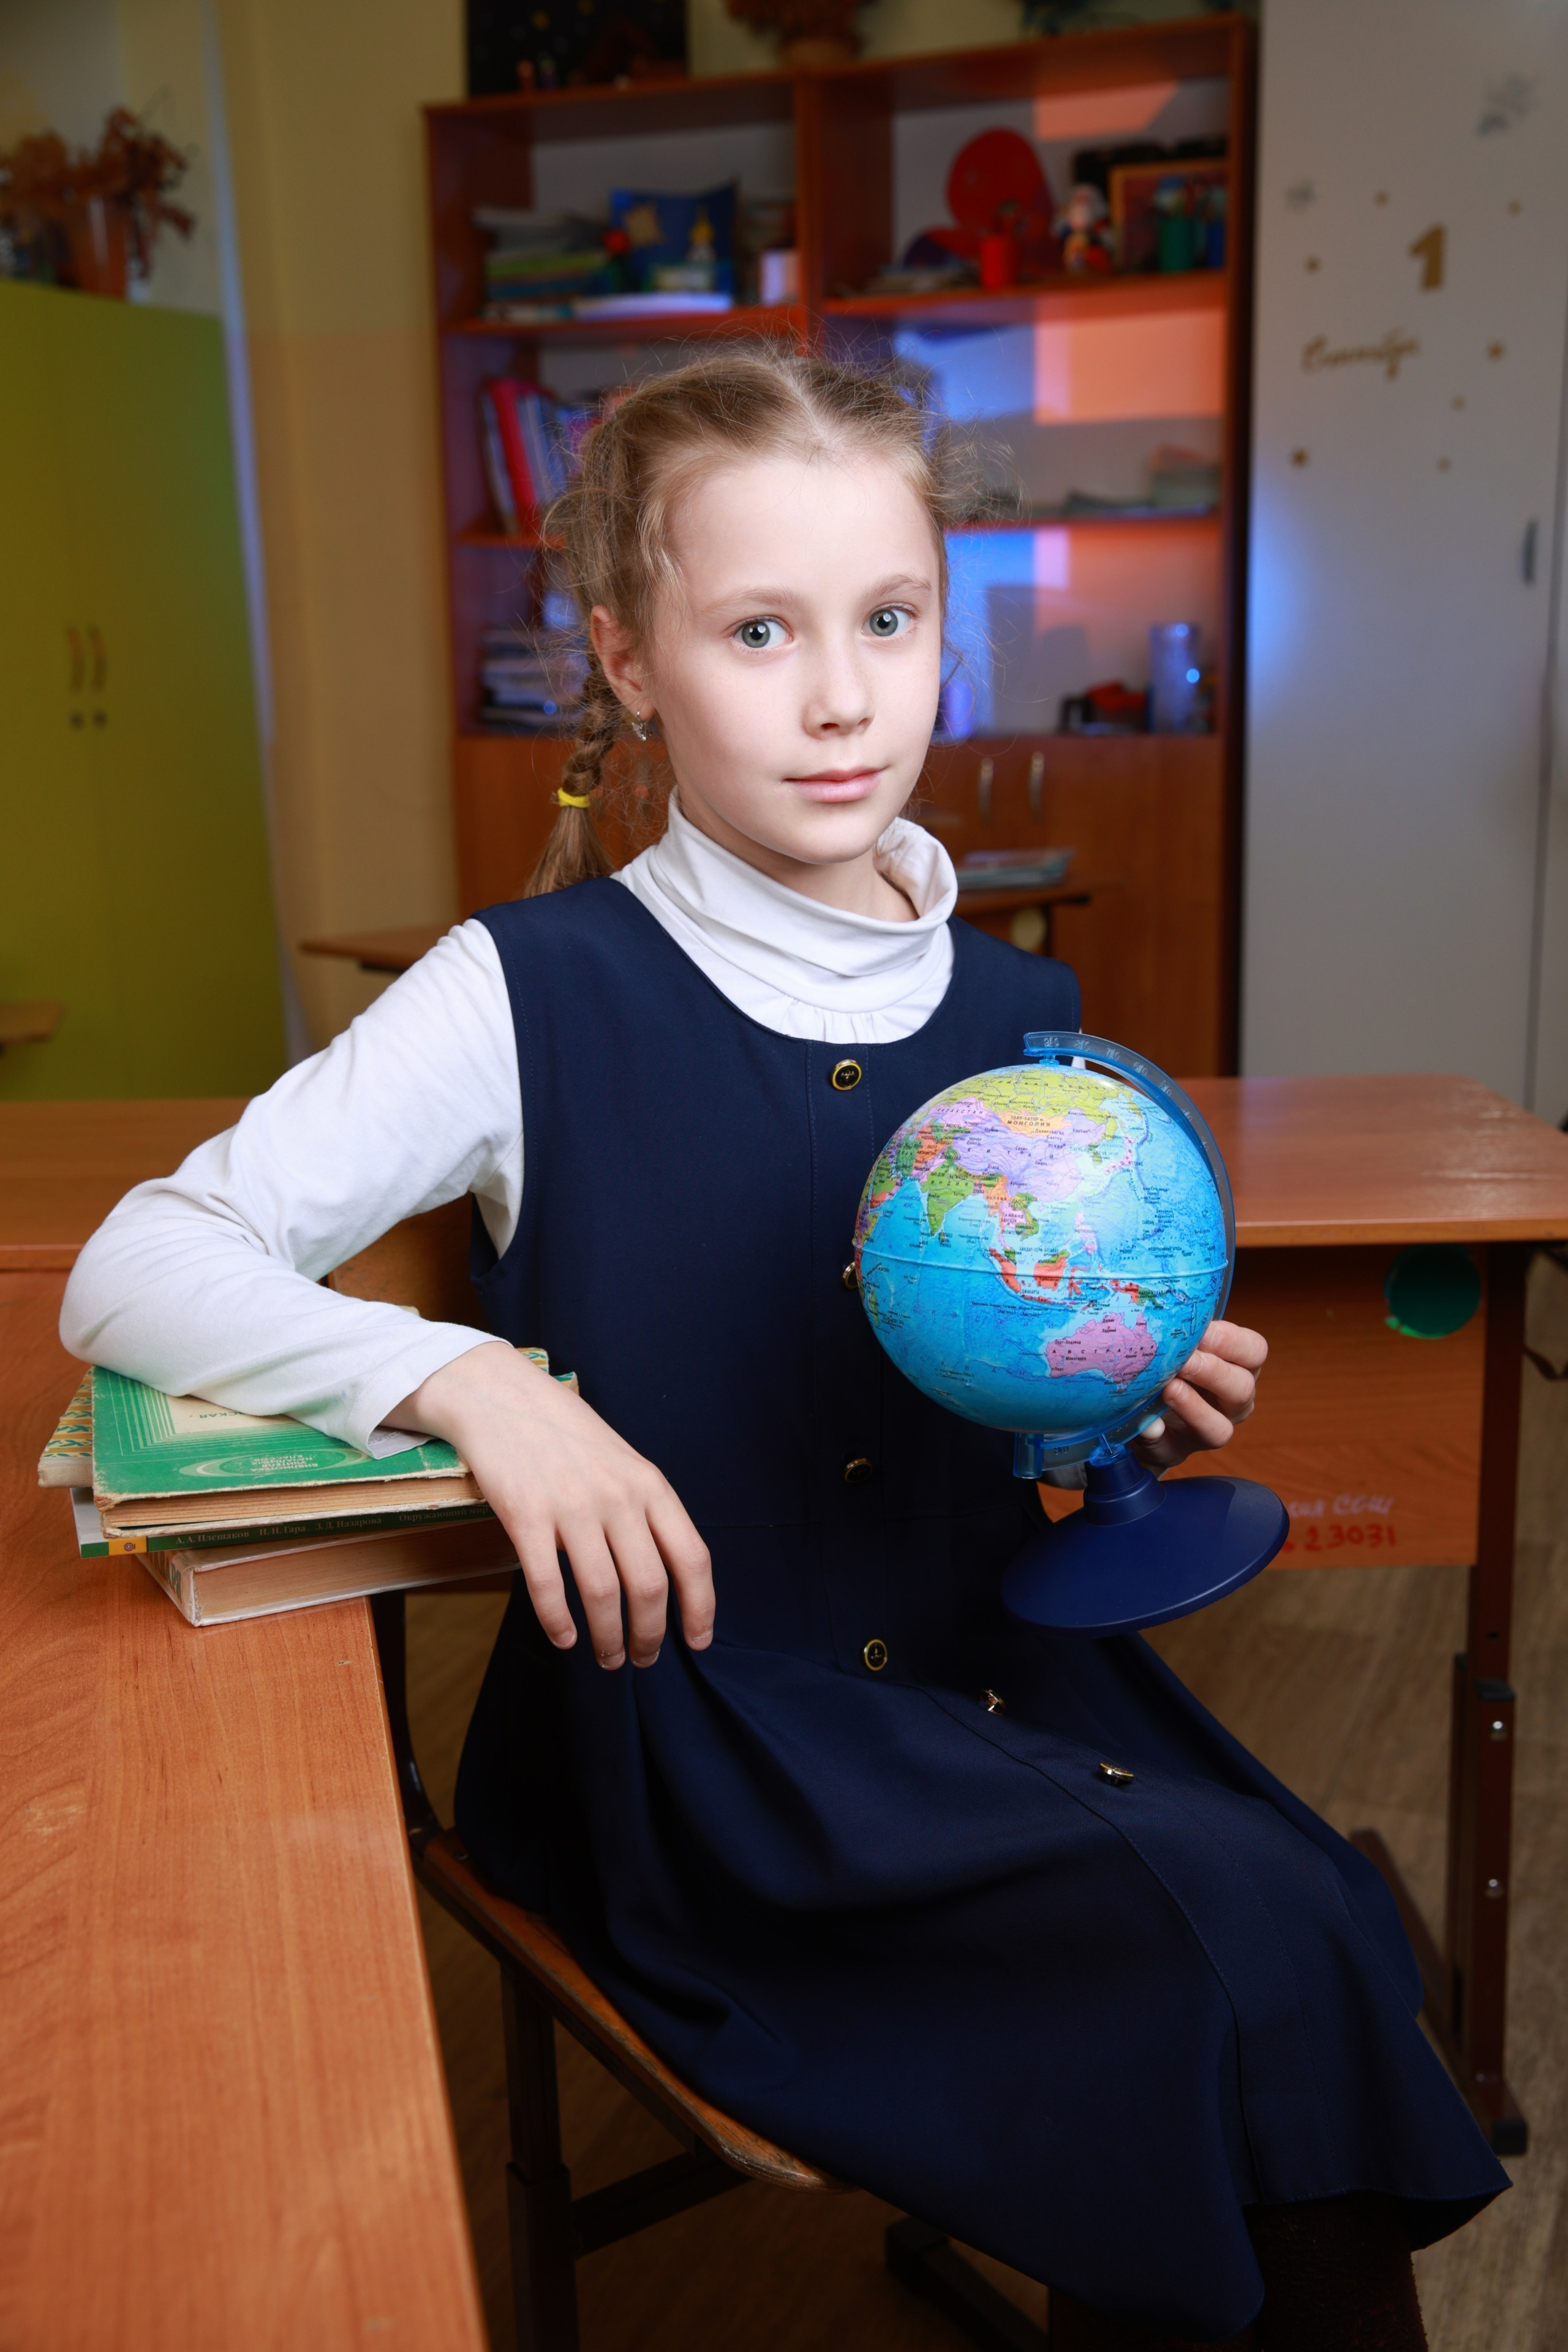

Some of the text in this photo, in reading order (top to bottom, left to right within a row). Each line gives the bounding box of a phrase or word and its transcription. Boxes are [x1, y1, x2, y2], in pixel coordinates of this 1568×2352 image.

[1408, 222, 1445, 290] 1
[967, 1147, 1055, 1159] КИТАЙ
[1052, 1345, 1155, 1354] АВСТРАЛИЯ
[250, 1463, 318, 1472] БИБЛИОТЕКА
[197, 1531, 249, 1542] Плешаков
[283, 1524, 306, 1535] Гара
[325, 1521, 334, 1530] Д.
[336, 1517, 382, 1528] Назарова
[399, 1509, 467, 1523] Окружающий
[469, 1506, 488, 1515] мир
